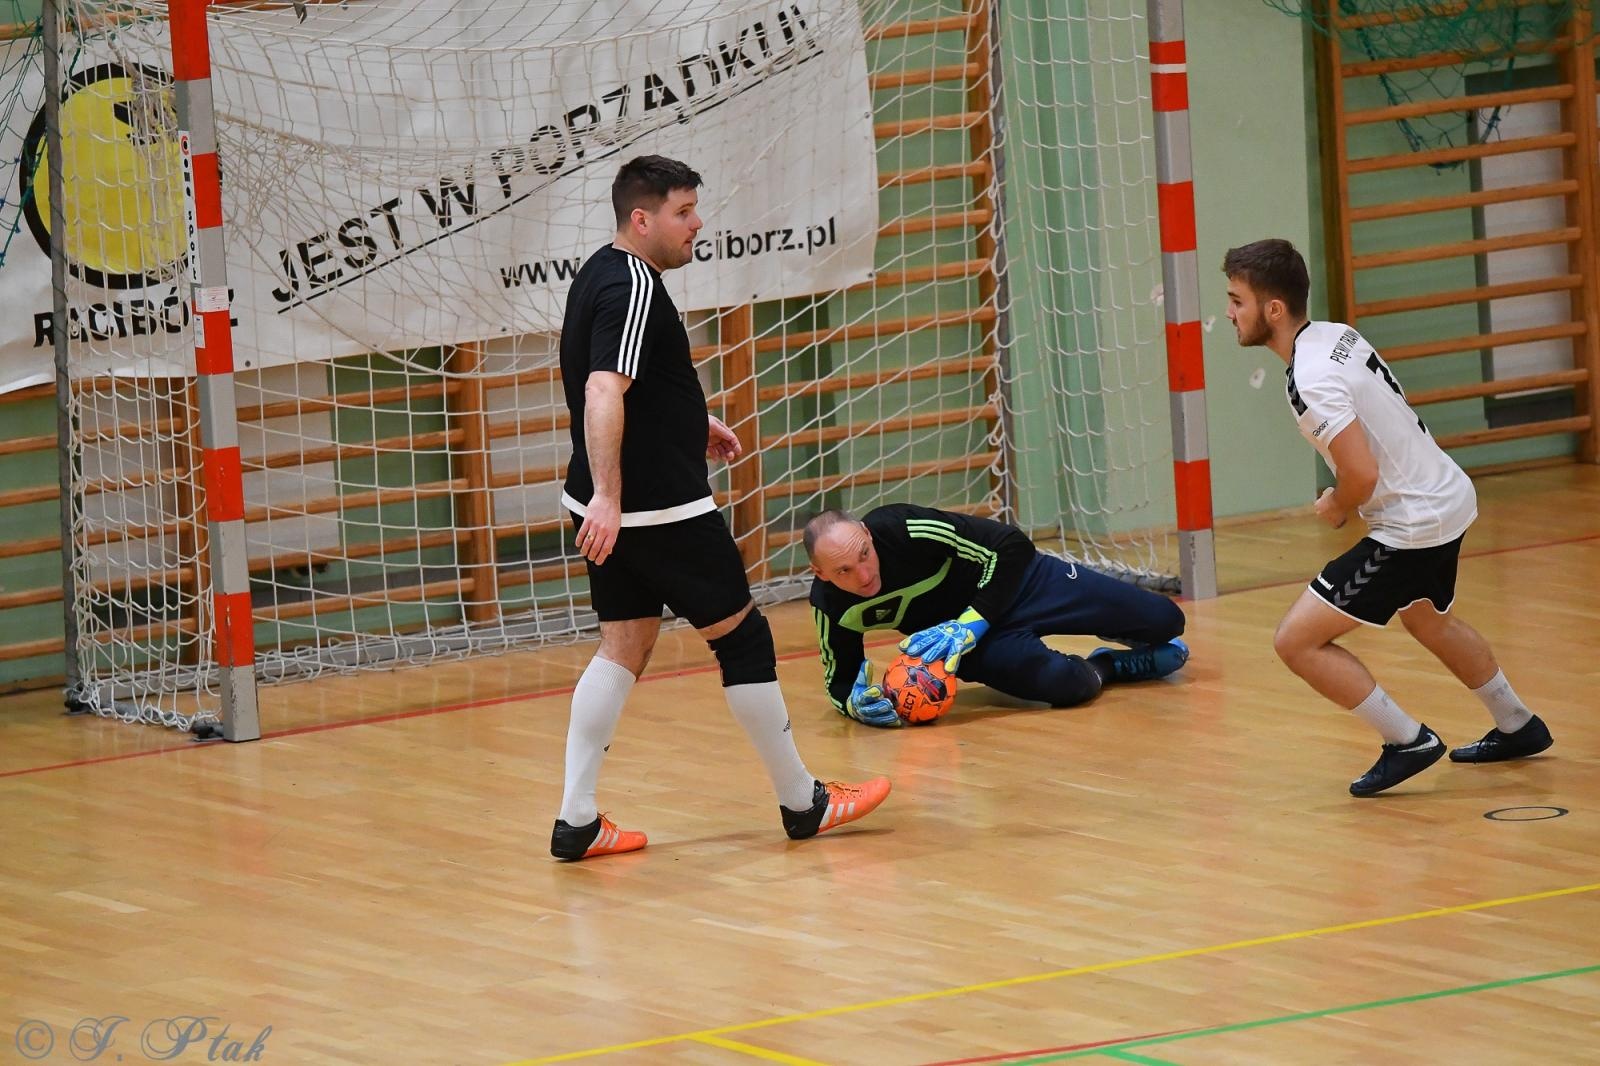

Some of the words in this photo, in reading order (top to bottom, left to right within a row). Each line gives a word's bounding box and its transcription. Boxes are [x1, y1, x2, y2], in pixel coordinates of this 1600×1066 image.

[272, 197, 404, 303] JEST
[414, 161, 479, 229] W
[34, 286, 238, 348] RACIBÓ
